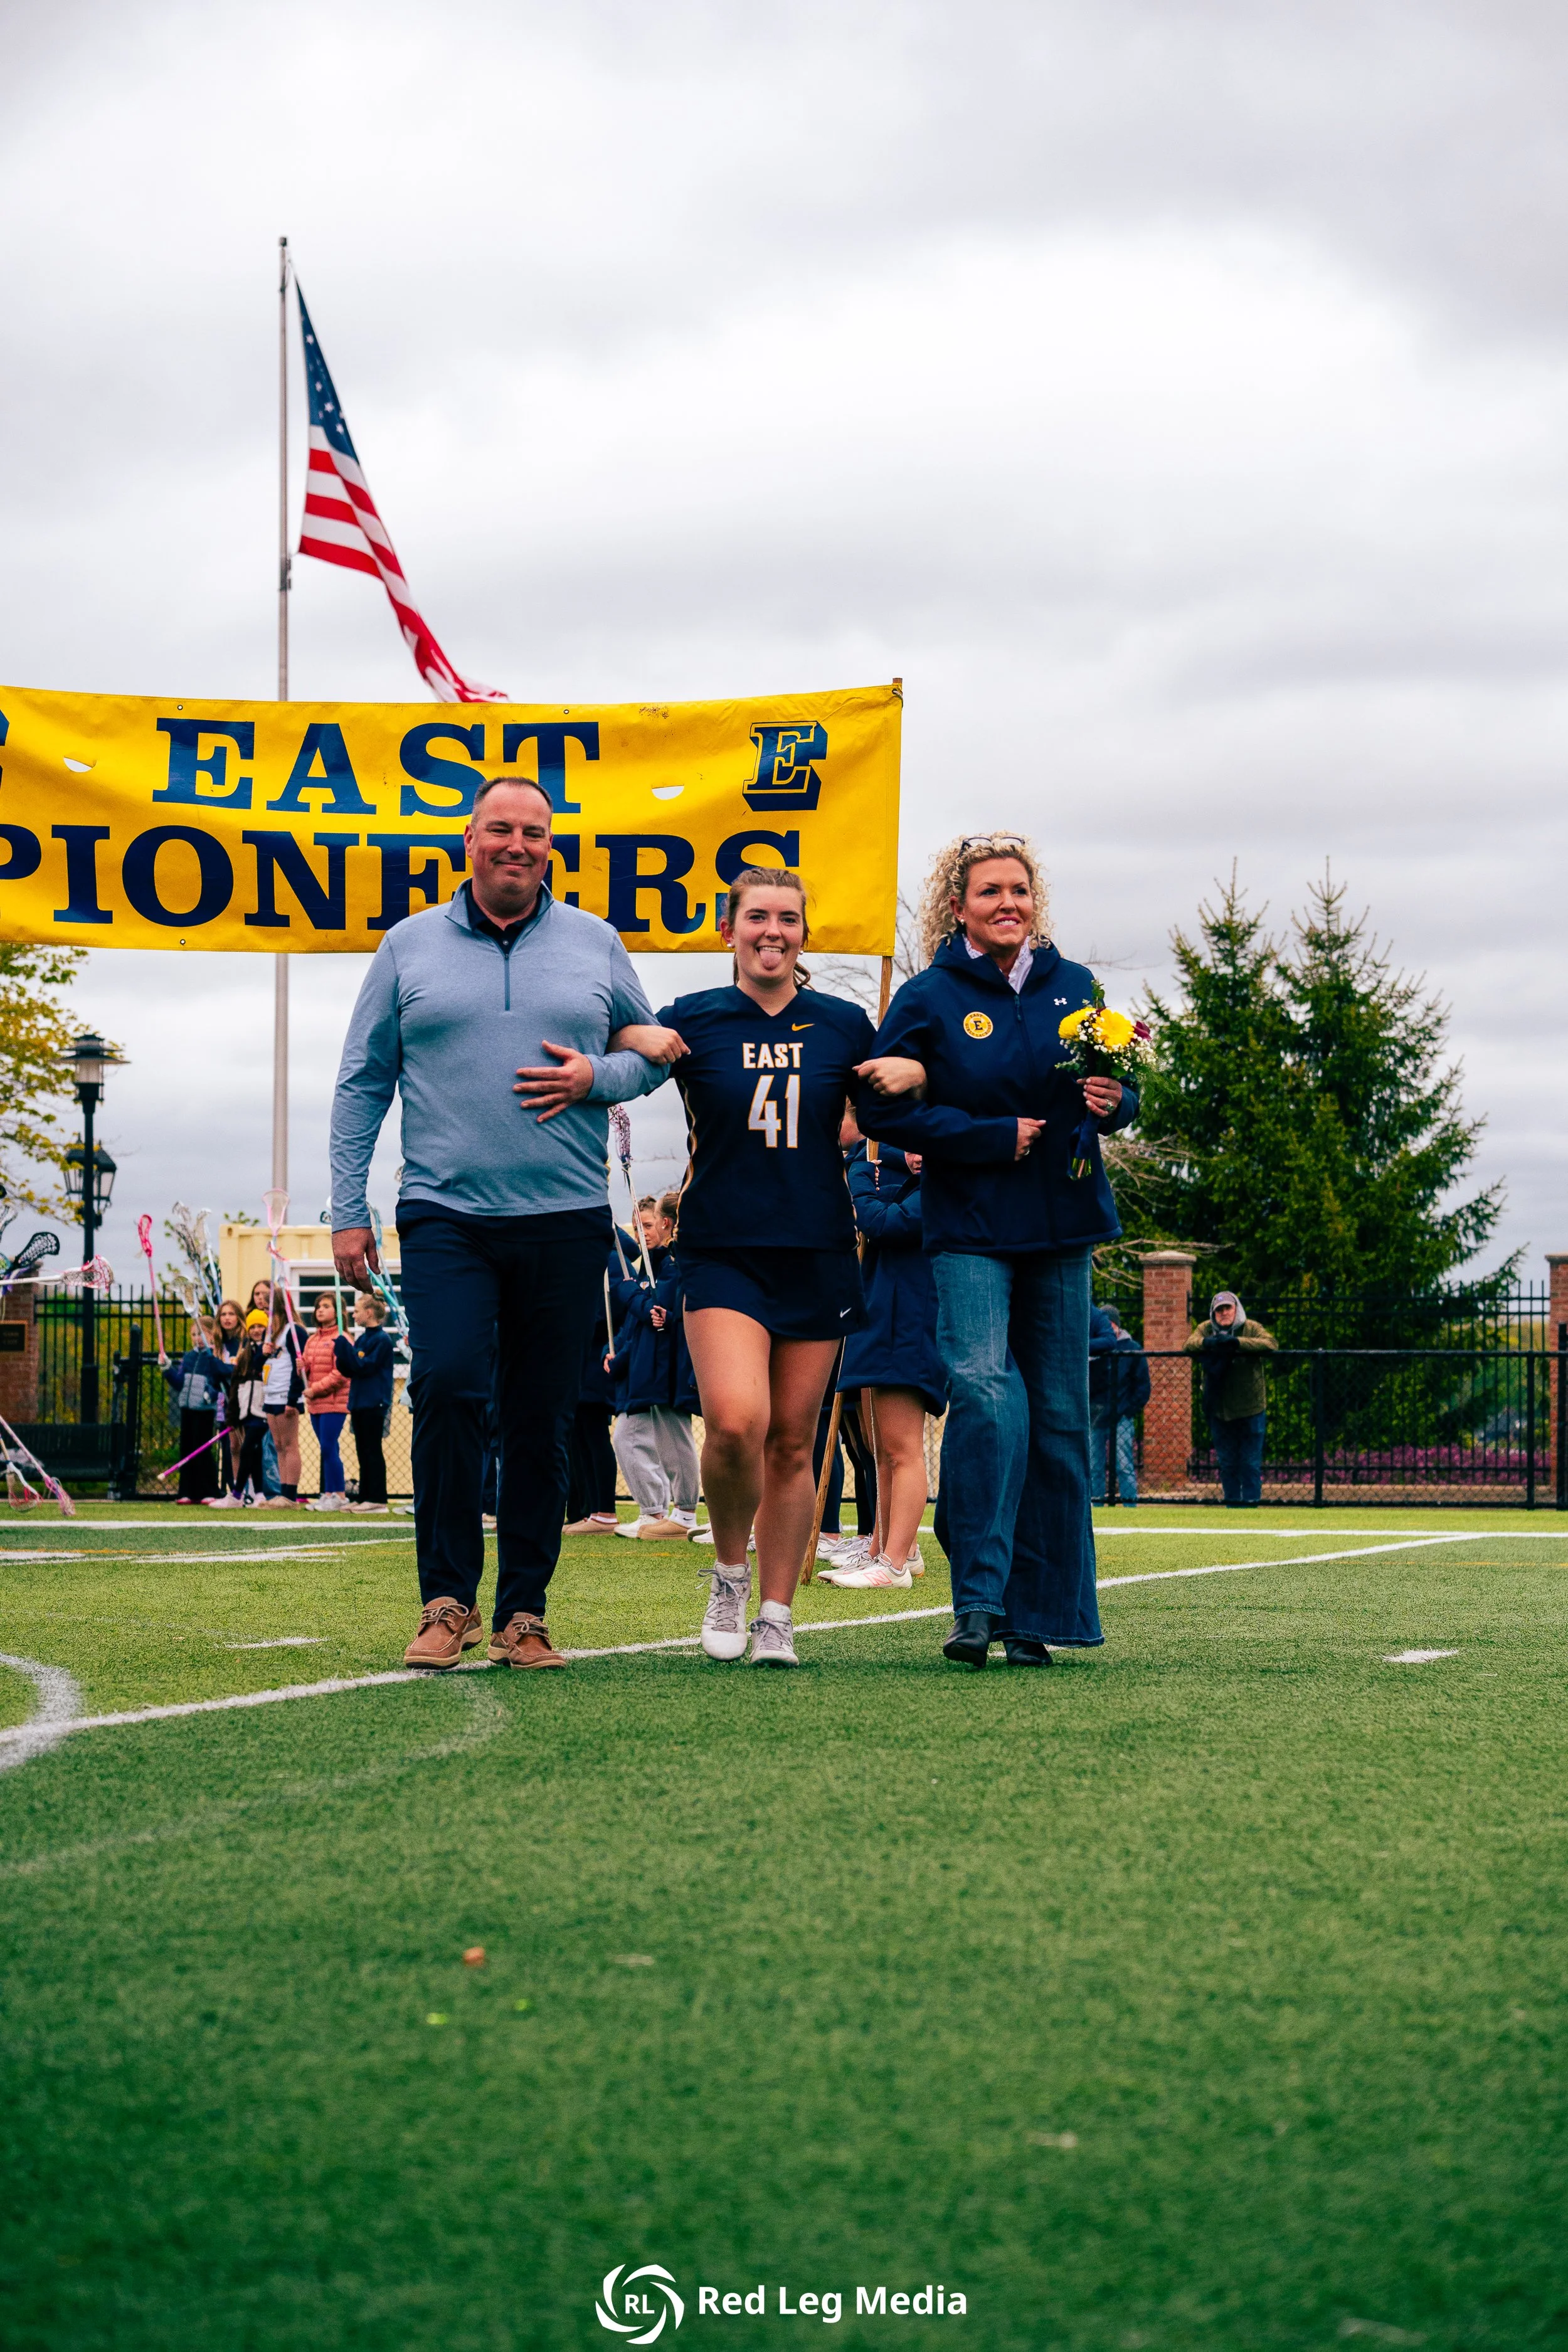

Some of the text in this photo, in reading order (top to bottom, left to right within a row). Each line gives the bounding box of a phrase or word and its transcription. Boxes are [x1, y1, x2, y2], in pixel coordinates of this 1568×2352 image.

[152, 718, 600, 817] EAST
[742, 720, 828, 812] E
[743, 1042, 803, 1069] EAST
[973, 1020, 983, 1030] E
[748, 1074, 800, 1148] 41
